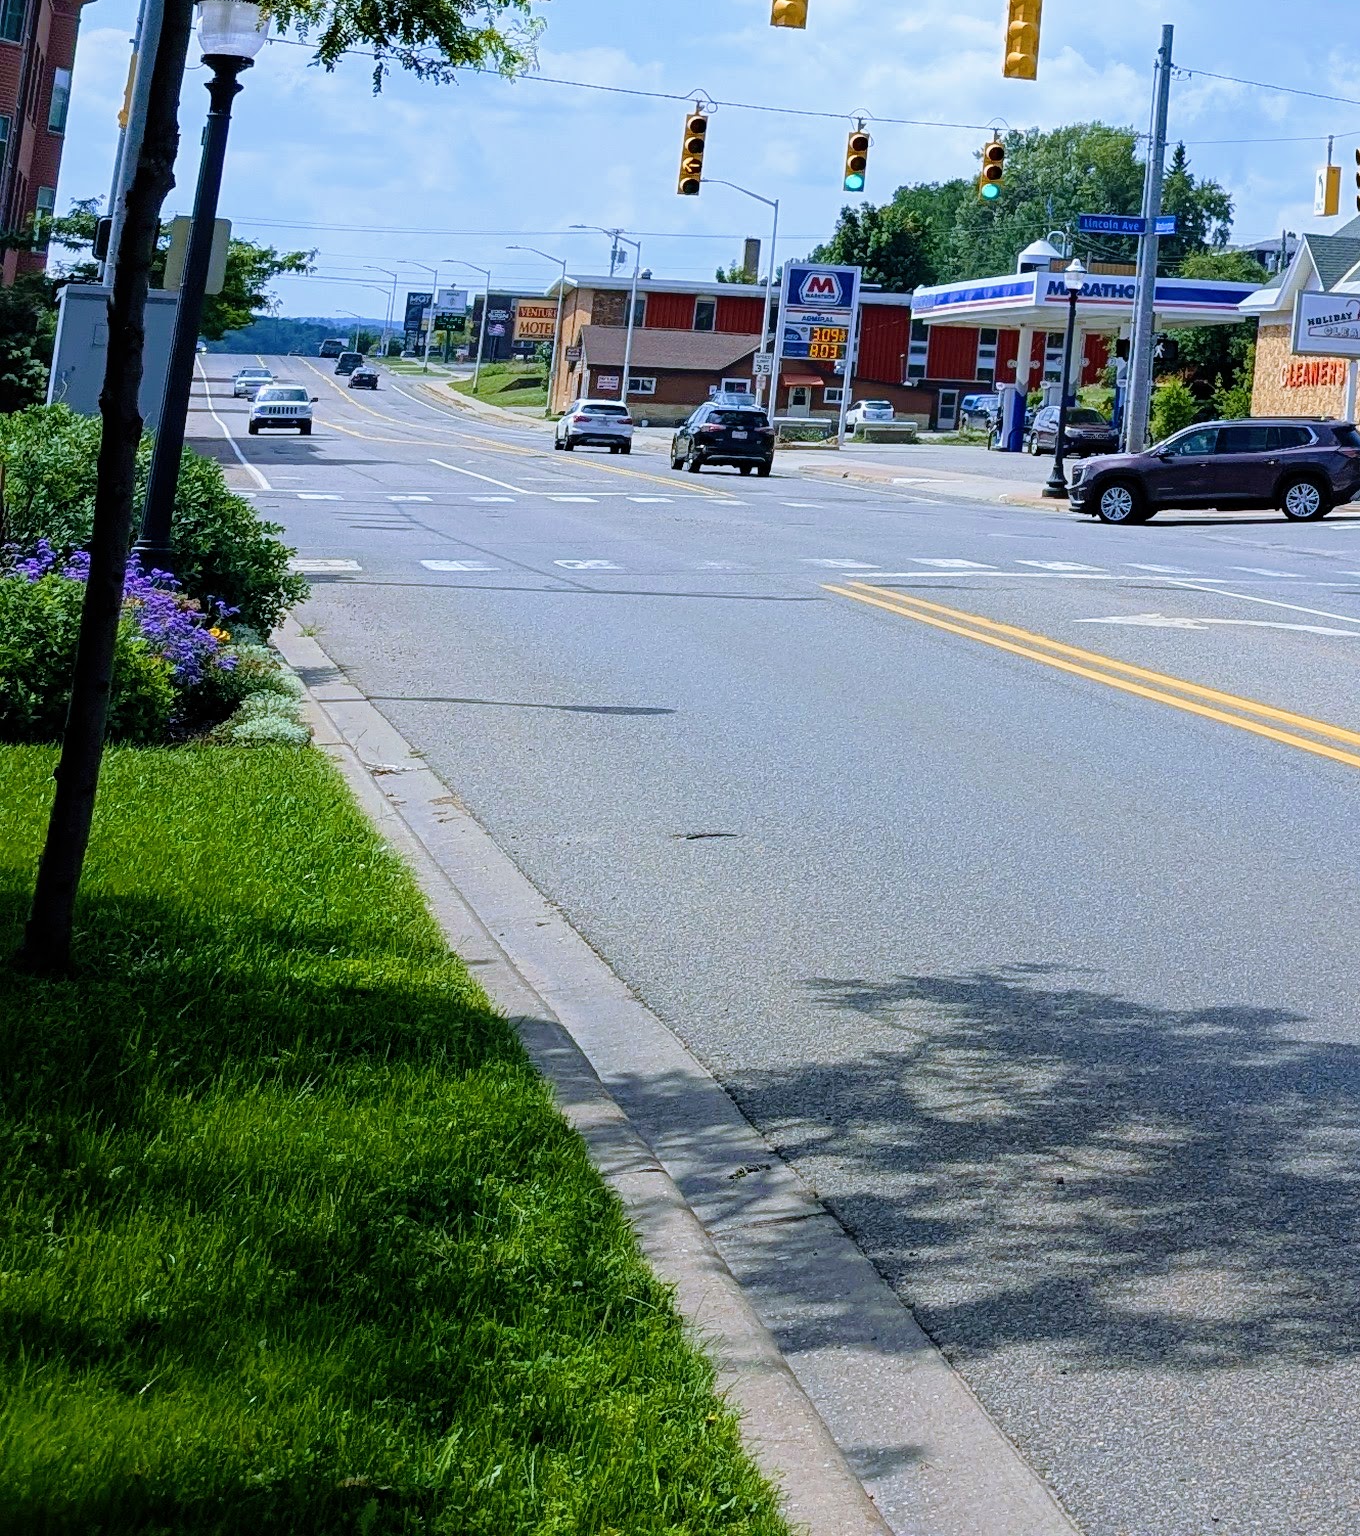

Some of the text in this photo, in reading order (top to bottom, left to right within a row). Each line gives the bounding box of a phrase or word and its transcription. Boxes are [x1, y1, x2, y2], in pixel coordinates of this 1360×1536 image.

[1084, 217, 1139, 231] Lincoln Ave
[1046, 280, 1136, 298] MRATHO
[801, 315, 835, 323] ADMIRAL
[1307, 311, 1353, 326] HOLIDAY
[755, 364, 770, 373] 35
[1280, 361, 1346, 388] CLEANERS
